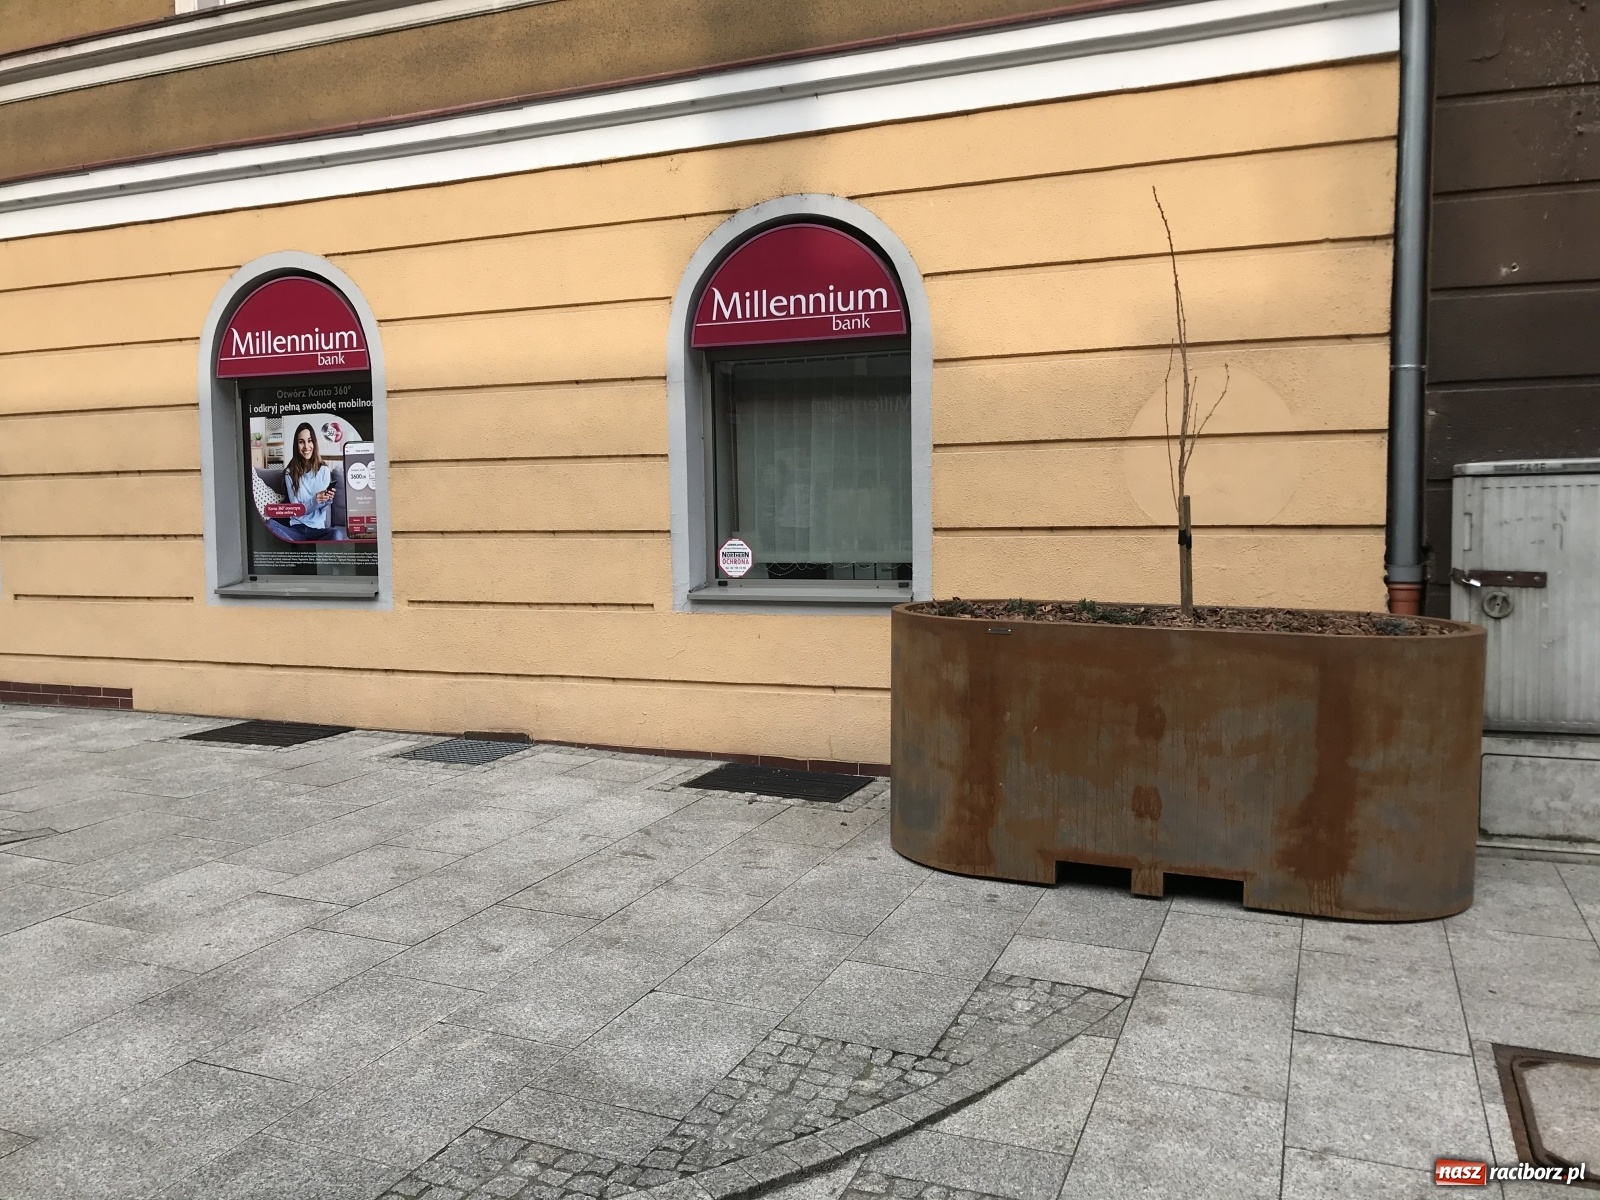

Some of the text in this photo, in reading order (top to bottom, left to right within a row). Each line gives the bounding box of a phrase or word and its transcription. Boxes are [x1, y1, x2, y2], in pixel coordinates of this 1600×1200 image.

[711, 285, 888, 320] Millennium
[832, 313, 871, 331] bank
[231, 327, 357, 356] Millennium
[318, 352, 345, 366] bank
[276, 385, 352, 399] Otwórz Konto 360°
[249, 404, 252, 413] i
[253, 403, 278, 414] odkryj
[280, 402, 301, 414] pełną
[302, 400, 337, 411] swobodę
